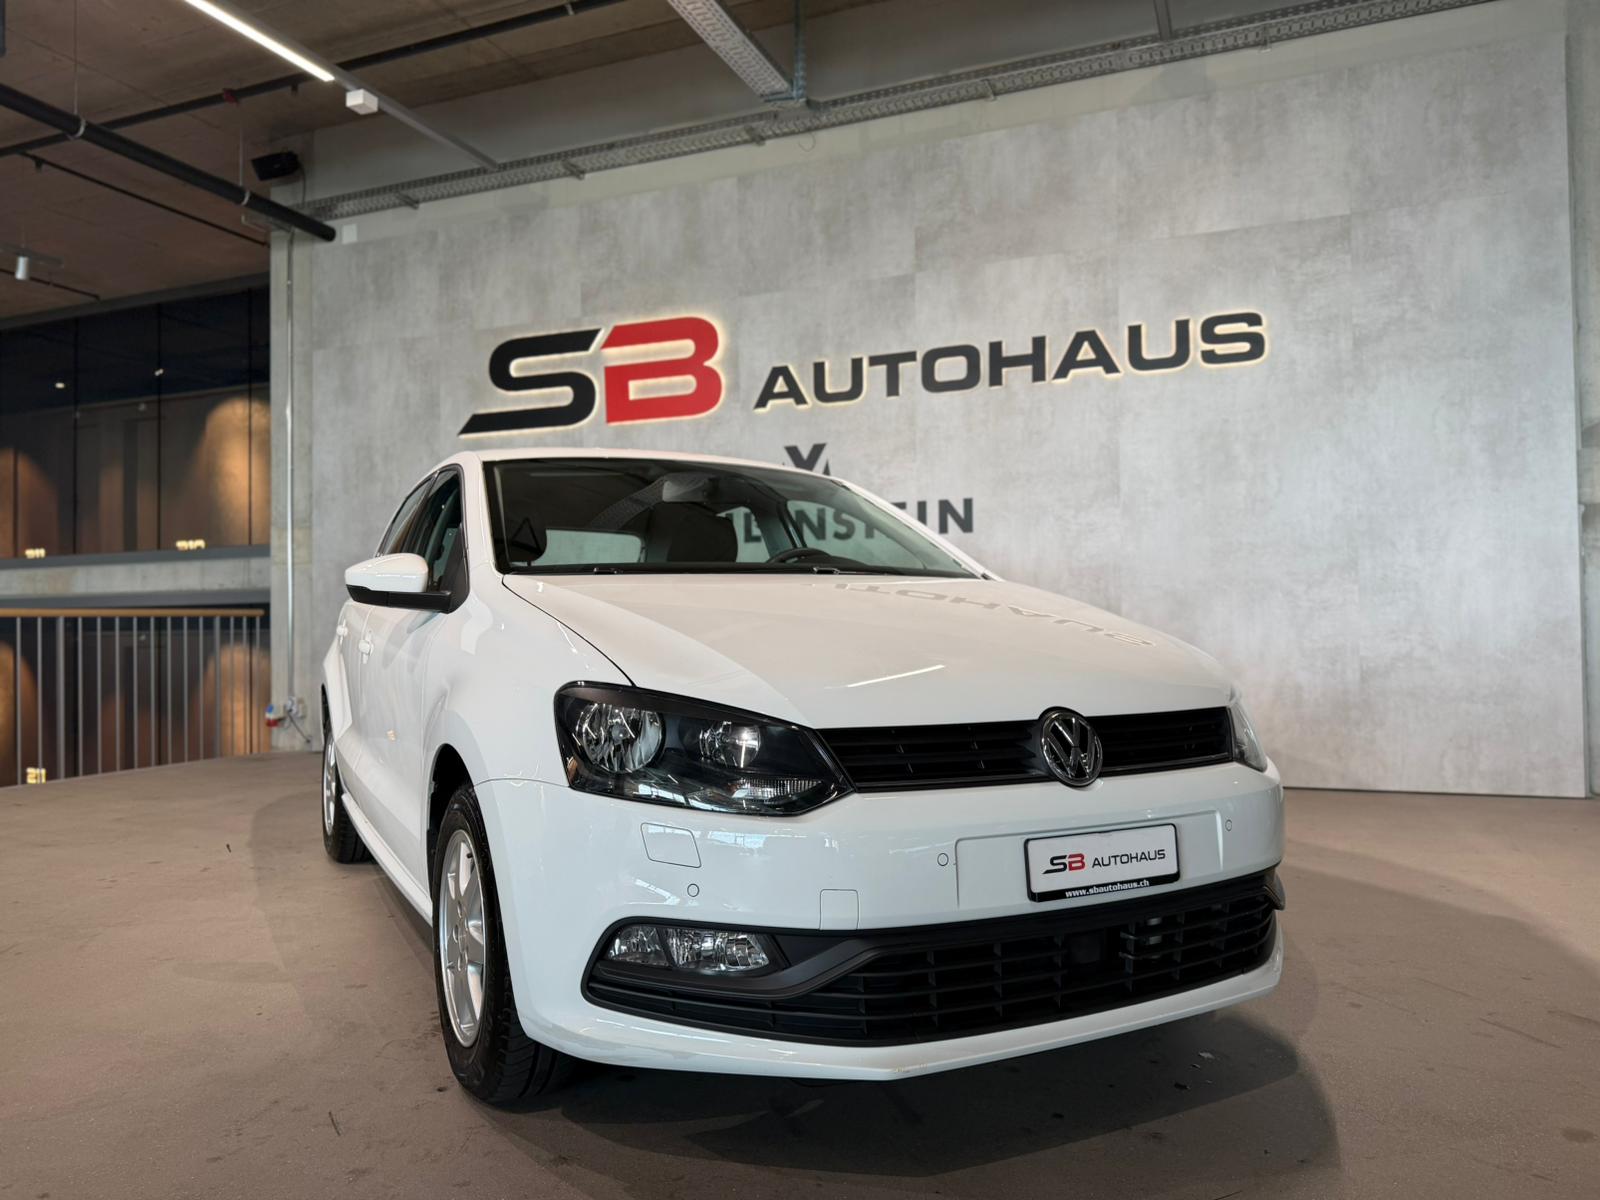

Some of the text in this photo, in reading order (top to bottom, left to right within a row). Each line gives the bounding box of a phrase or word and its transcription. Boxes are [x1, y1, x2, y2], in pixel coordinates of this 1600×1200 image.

[457, 311, 1267, 436] SB AUTOHAUS
[1042, 848, 1166, 875] SB AUTOHAUS
[1065, 879, 1150, 898] www.sbautohaus.ch
